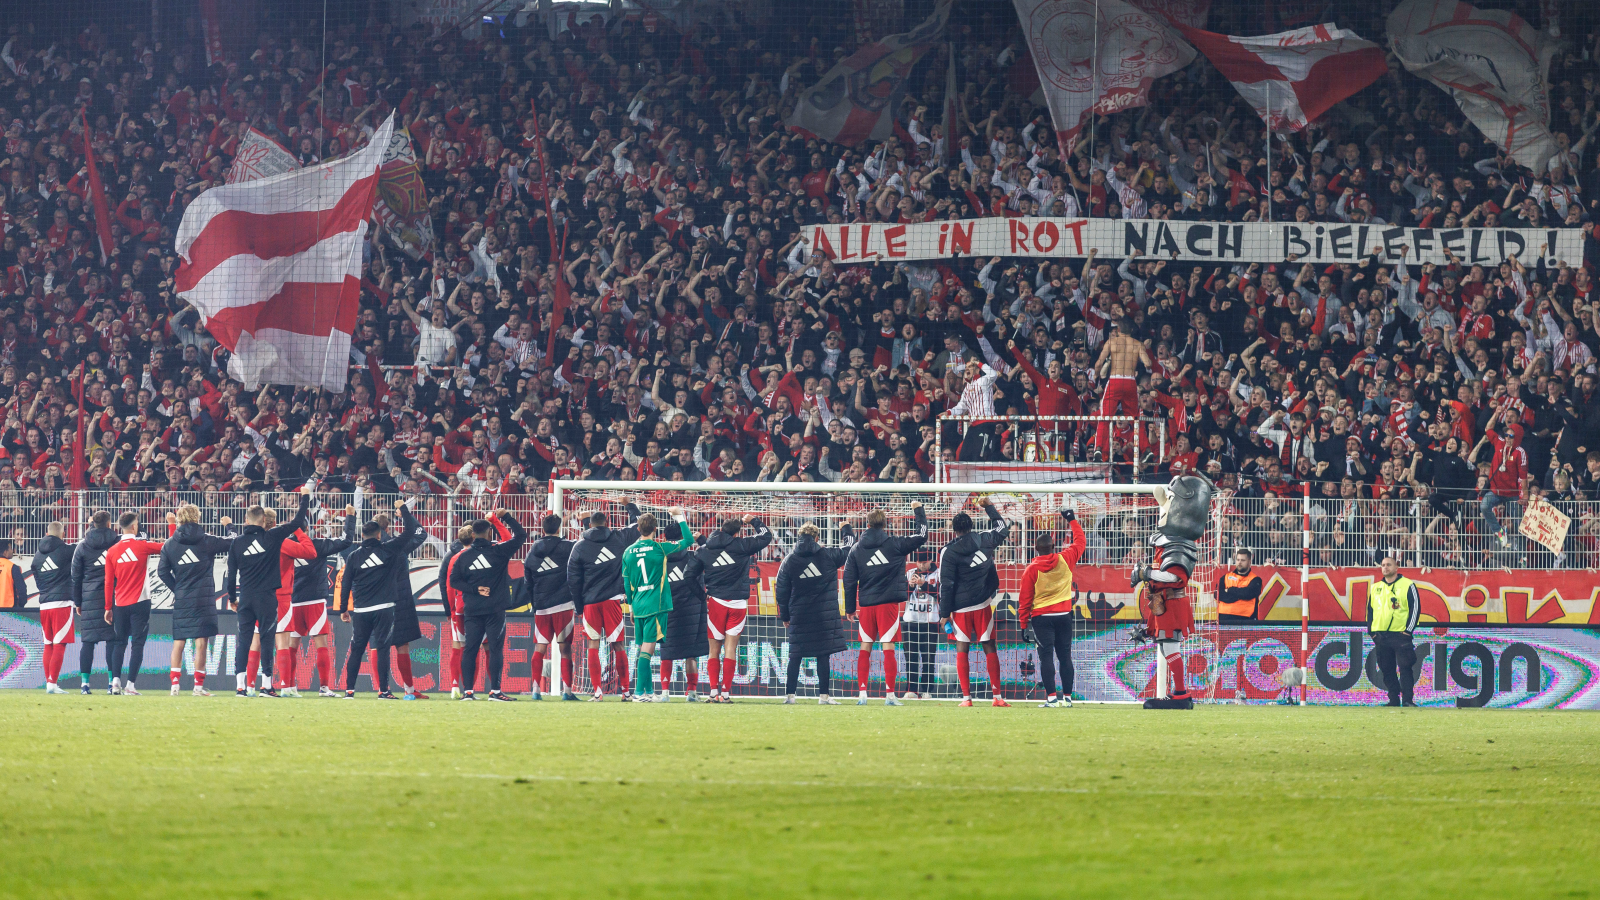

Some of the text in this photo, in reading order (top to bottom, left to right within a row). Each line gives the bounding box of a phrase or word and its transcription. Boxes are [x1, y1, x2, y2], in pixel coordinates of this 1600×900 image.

[812, 224, 907, 260] ALLE
[1009, 219, 1088, 255] ROT
[1125, 221, 1243, 257] NACH
[637, 557, 649, 584] 1
